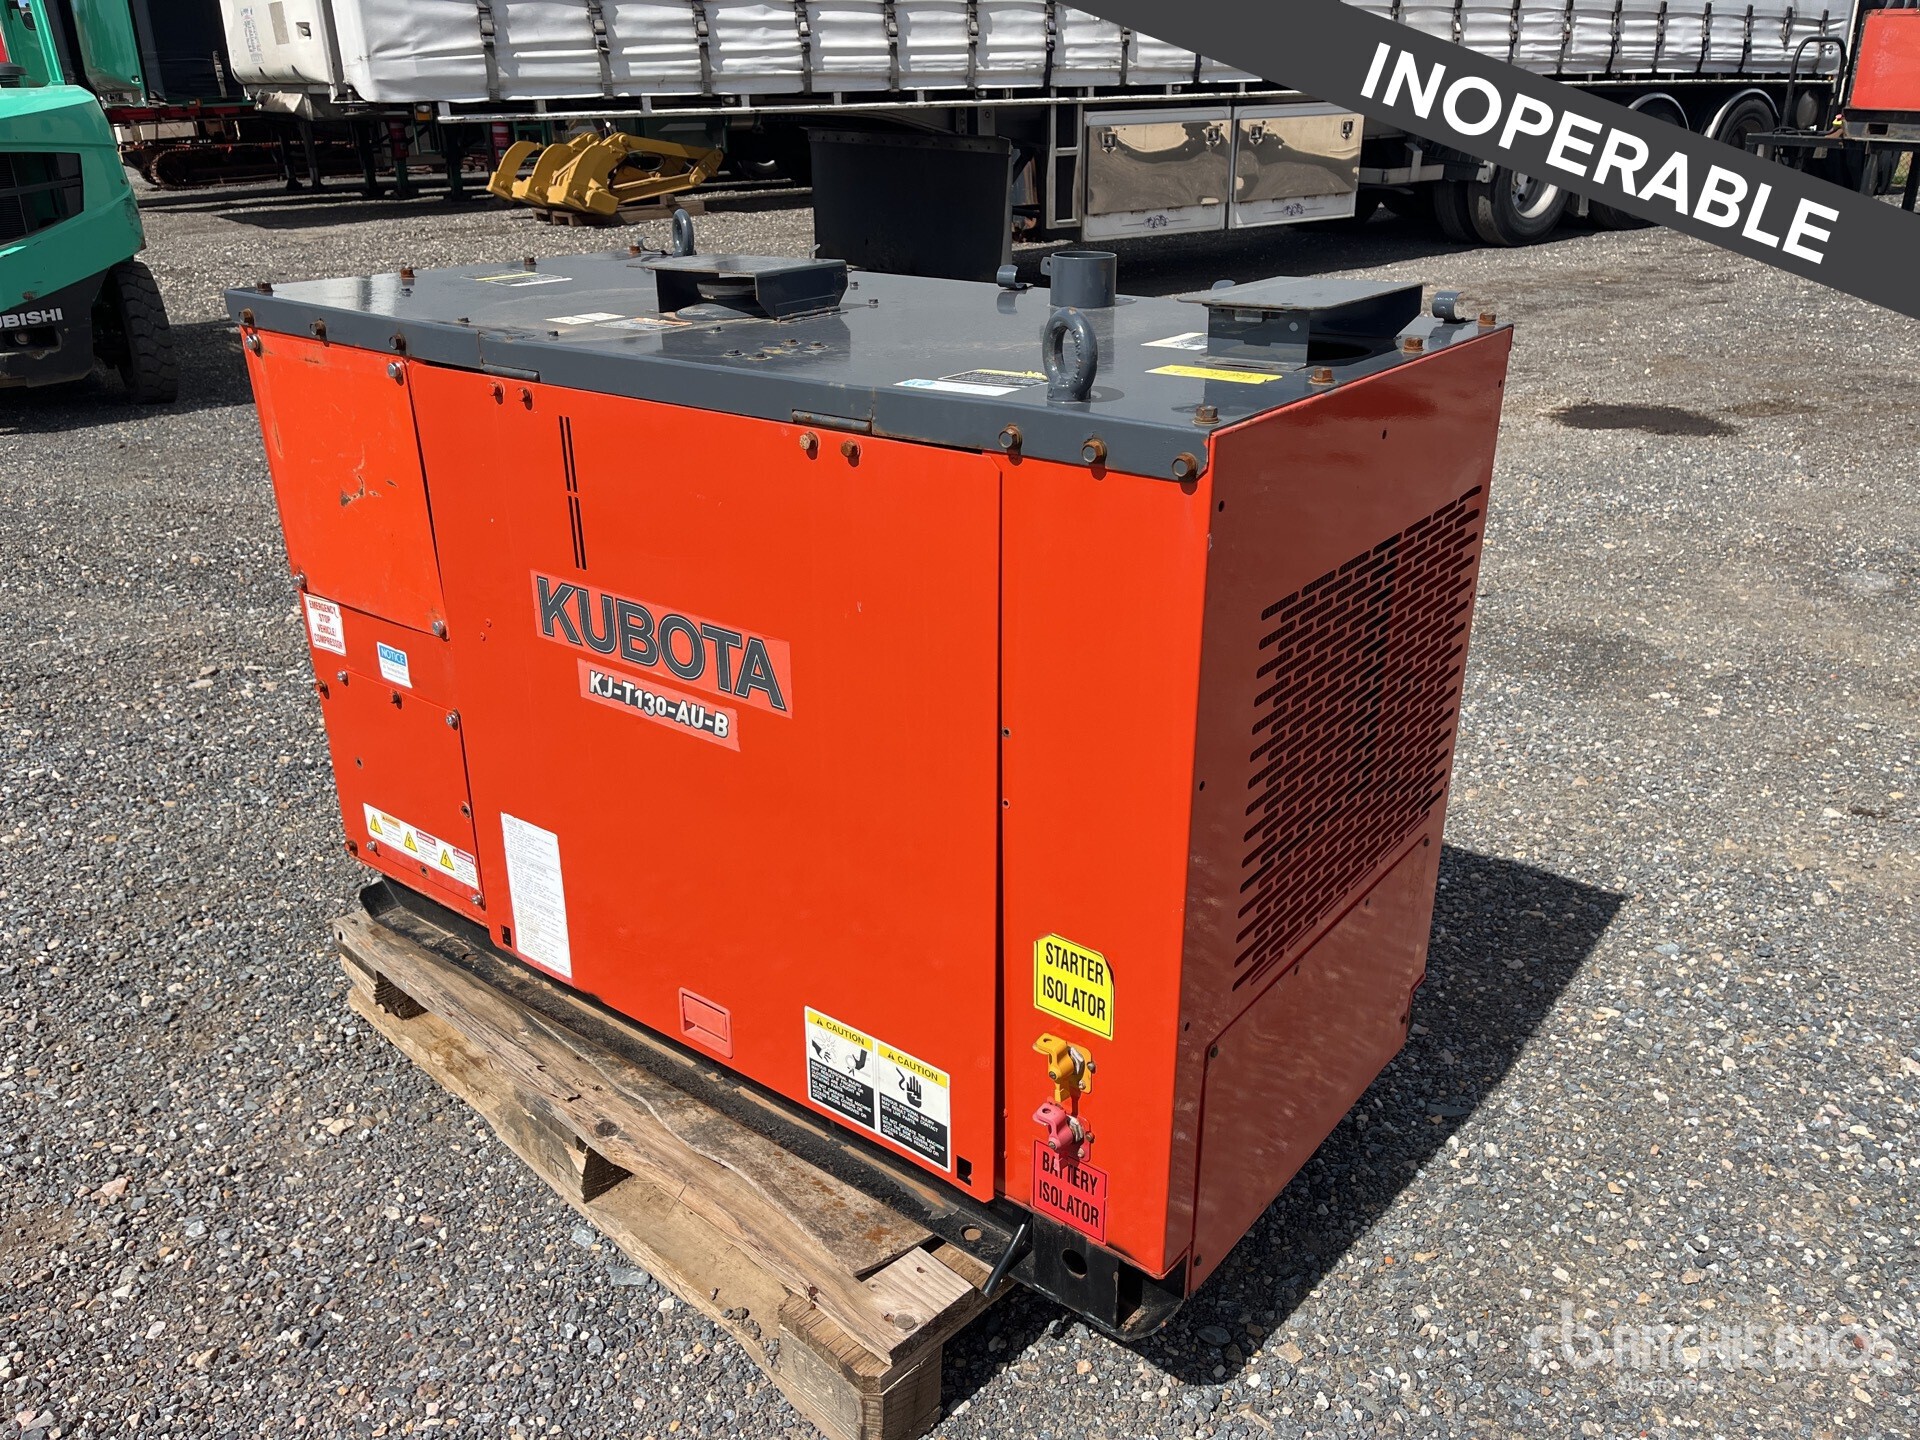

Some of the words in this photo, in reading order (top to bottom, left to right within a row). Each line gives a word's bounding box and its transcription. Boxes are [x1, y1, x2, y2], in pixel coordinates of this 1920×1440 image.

[0, 307, 64, 329] BISHI
[318, 613, 331, 623] STOP
[380, 647, 405, 665] NOTICE
[537, 577, 788, 712] KUBOTA
[589, 669, 729, 739] KJ-T130-AU-B
[1046, 942, 1103, 986] STARTER
[1043, 974, 1106, 1021] ISOLATOR
[826, 1021, 864, 1046] CAUTION
[897, 1055, 938, 1082] CAUTION
[1039, 1179, 1099, 1228] ISOLATOR
